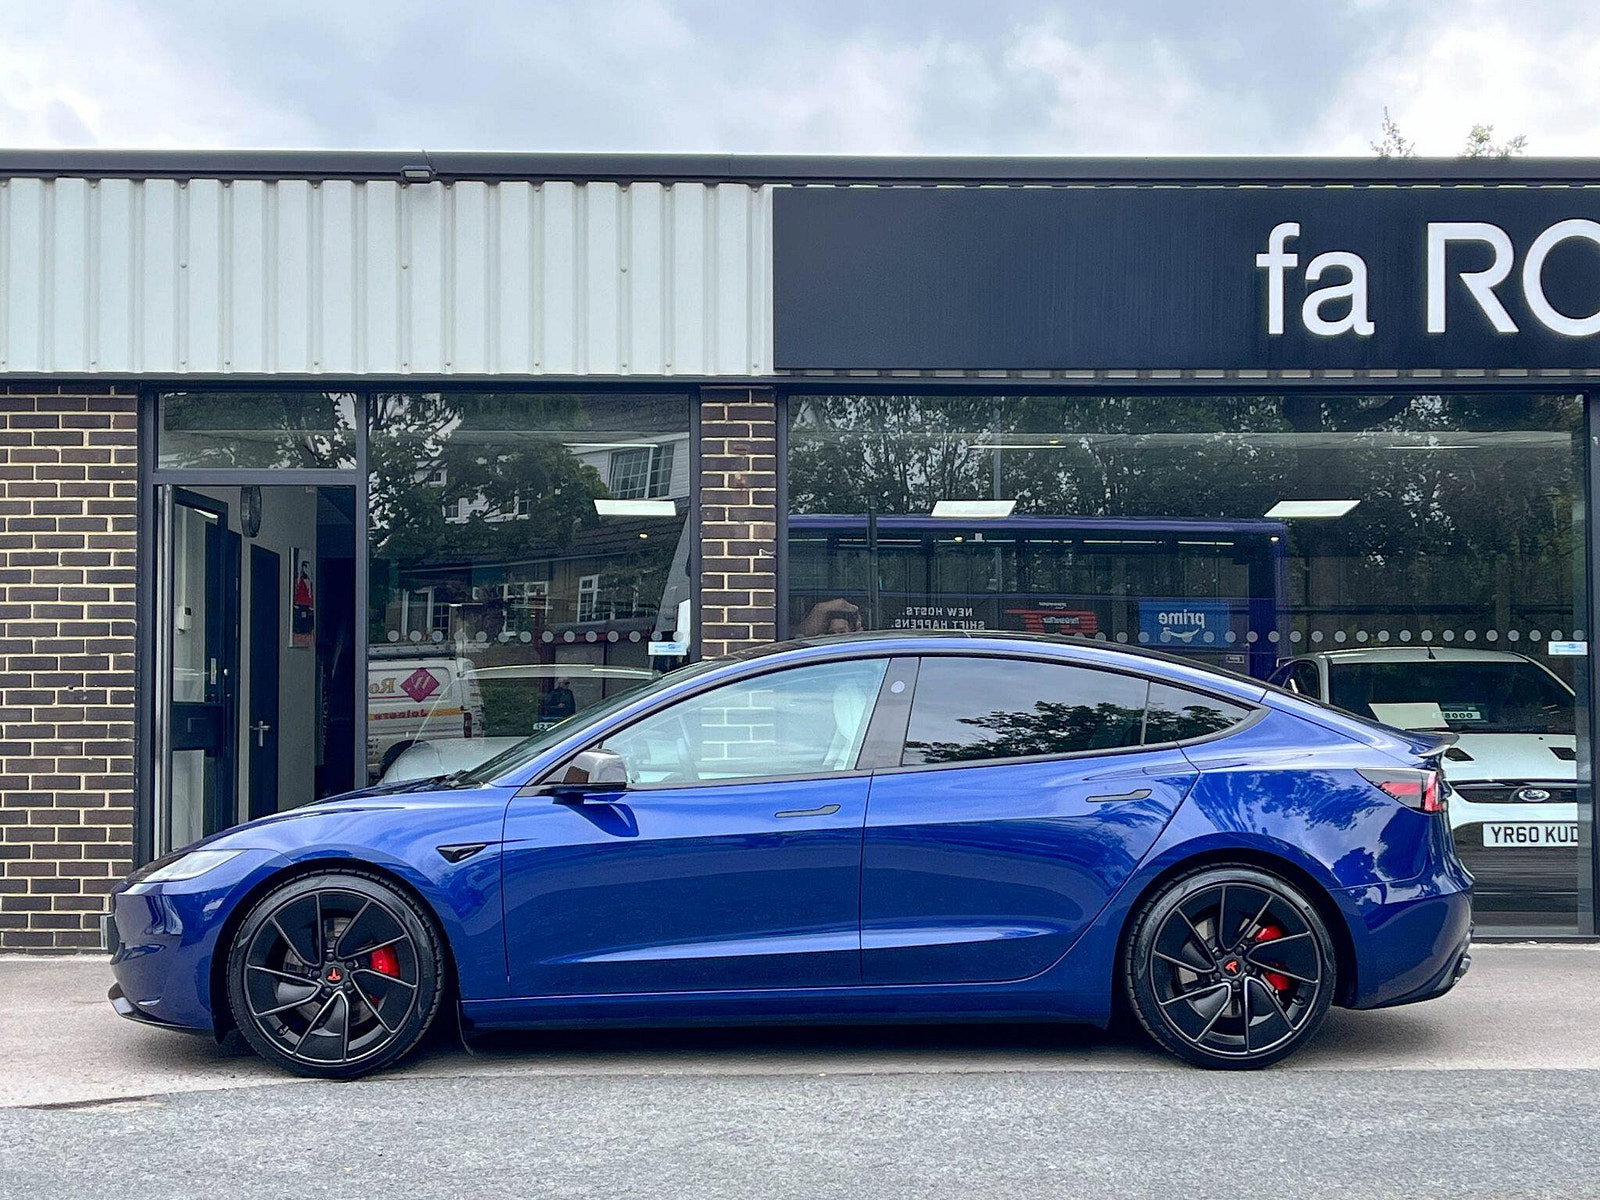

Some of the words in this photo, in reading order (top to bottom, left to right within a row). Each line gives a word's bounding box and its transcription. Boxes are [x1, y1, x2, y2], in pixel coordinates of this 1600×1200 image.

[1256, 221, 1375, 336] fa
[1427, 218, 1600, 336] RO
[1491, 826, 1539, 843] YR60
